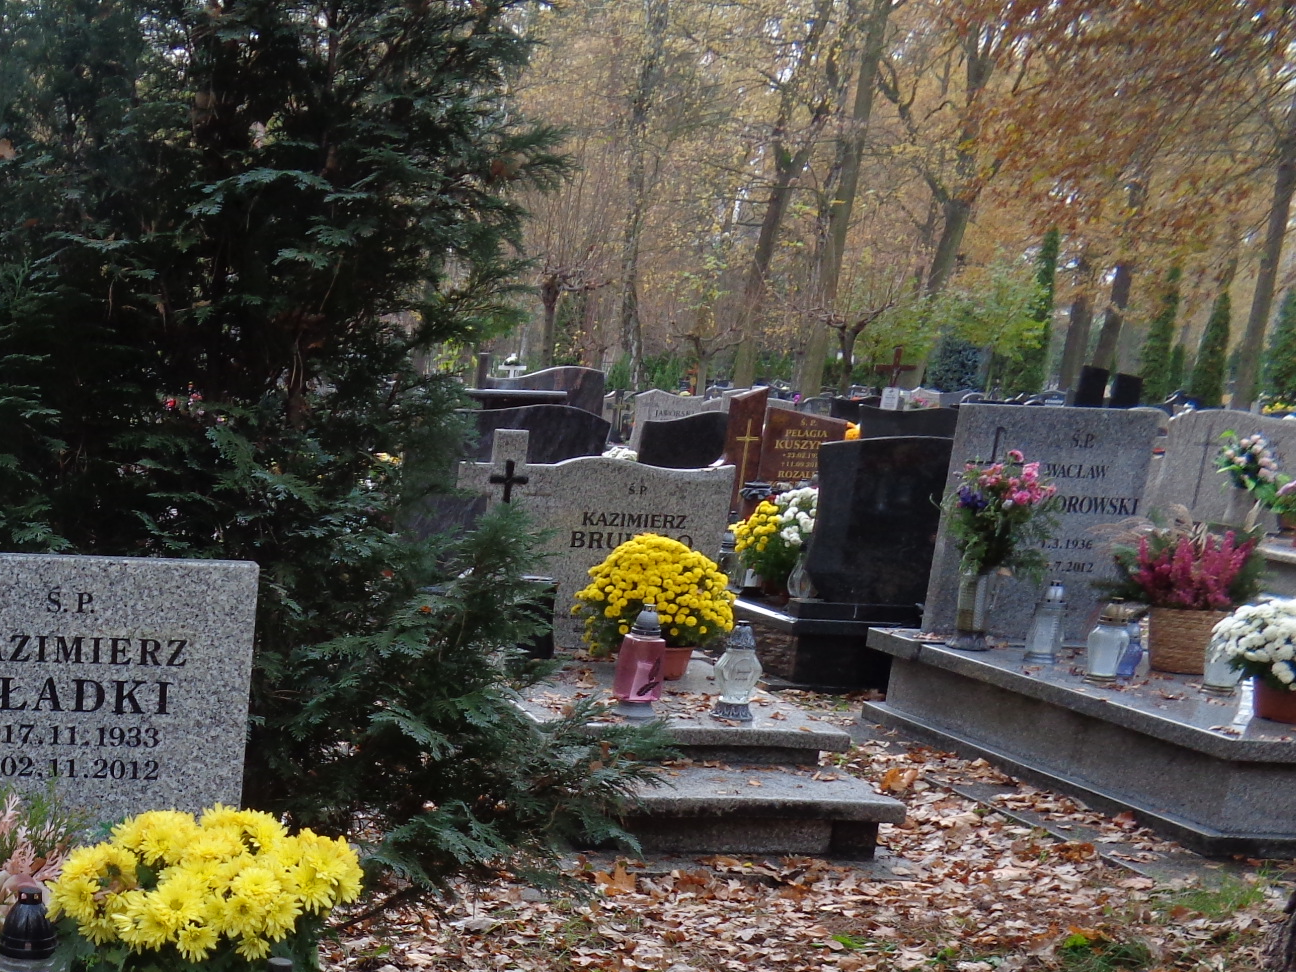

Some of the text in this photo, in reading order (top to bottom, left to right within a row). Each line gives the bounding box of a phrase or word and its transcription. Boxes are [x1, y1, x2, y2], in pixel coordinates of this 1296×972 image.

[784, 429, 828, 438] PELAGIA
[581, 511, 688, 530] KAZIMIERZ
[569, 530, 694, 550] BRUO
[1046, 561, 1094, 573] .7.2012
[1, 723, 161, 749] 17.11.1933
[0, 755, 160, 781] 02.11.2012
